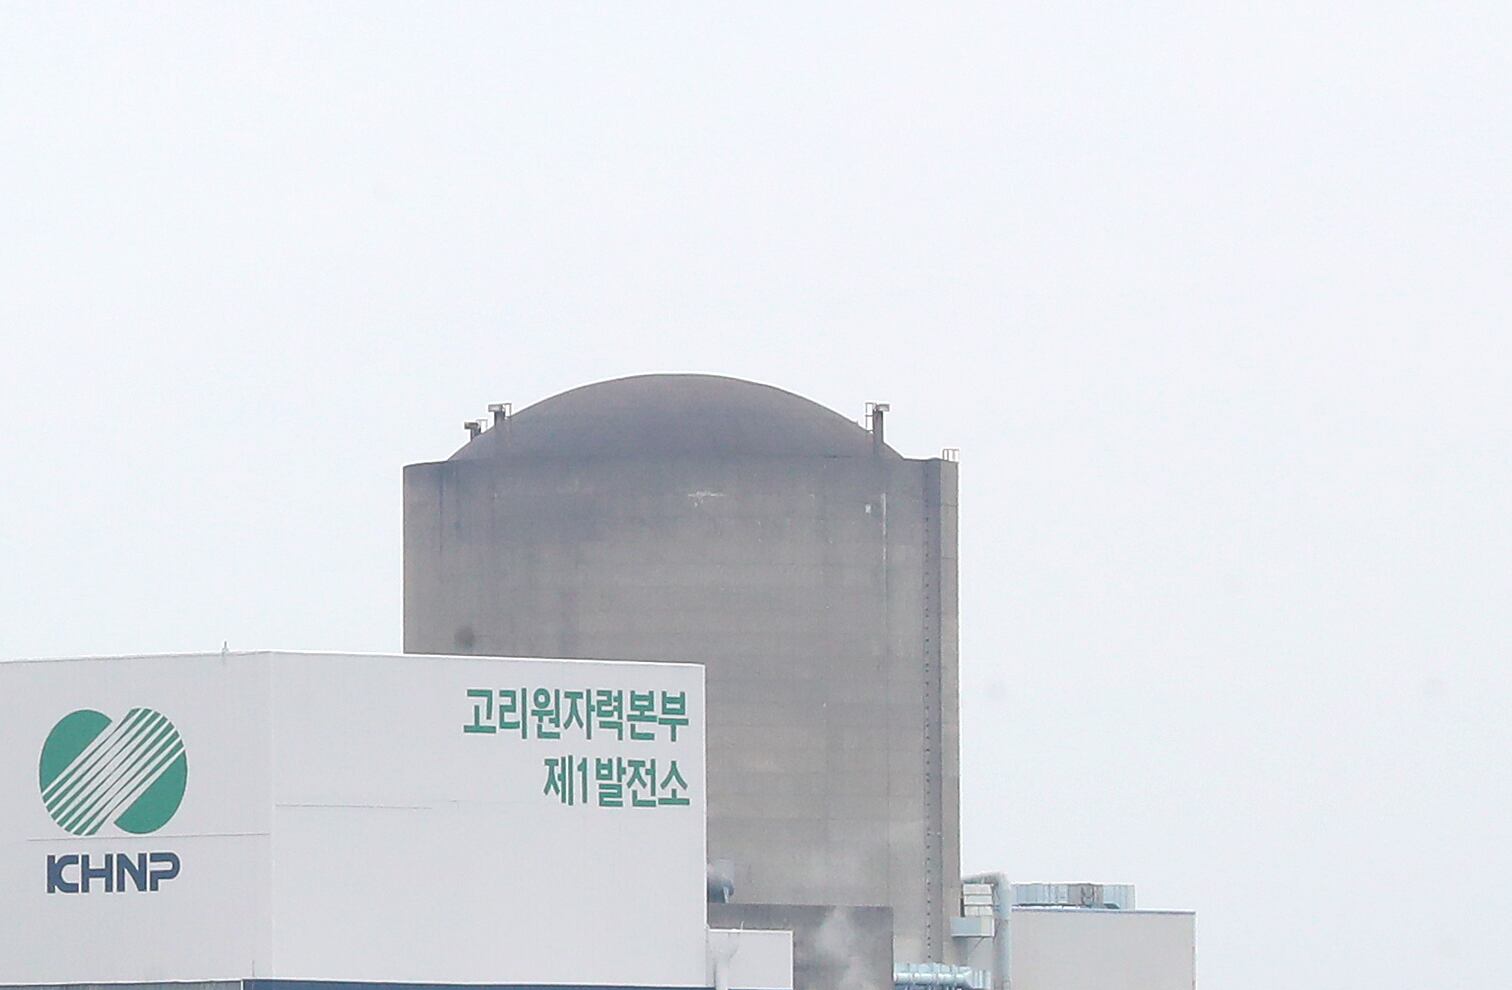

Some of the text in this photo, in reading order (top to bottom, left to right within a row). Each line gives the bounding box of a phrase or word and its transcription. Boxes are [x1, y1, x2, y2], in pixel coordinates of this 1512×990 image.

[463, 687, 689, 742] 고리원자력본부
[543, 754, 691, 808] 제1발전소
[46, 851, 181, 894] KHNP
